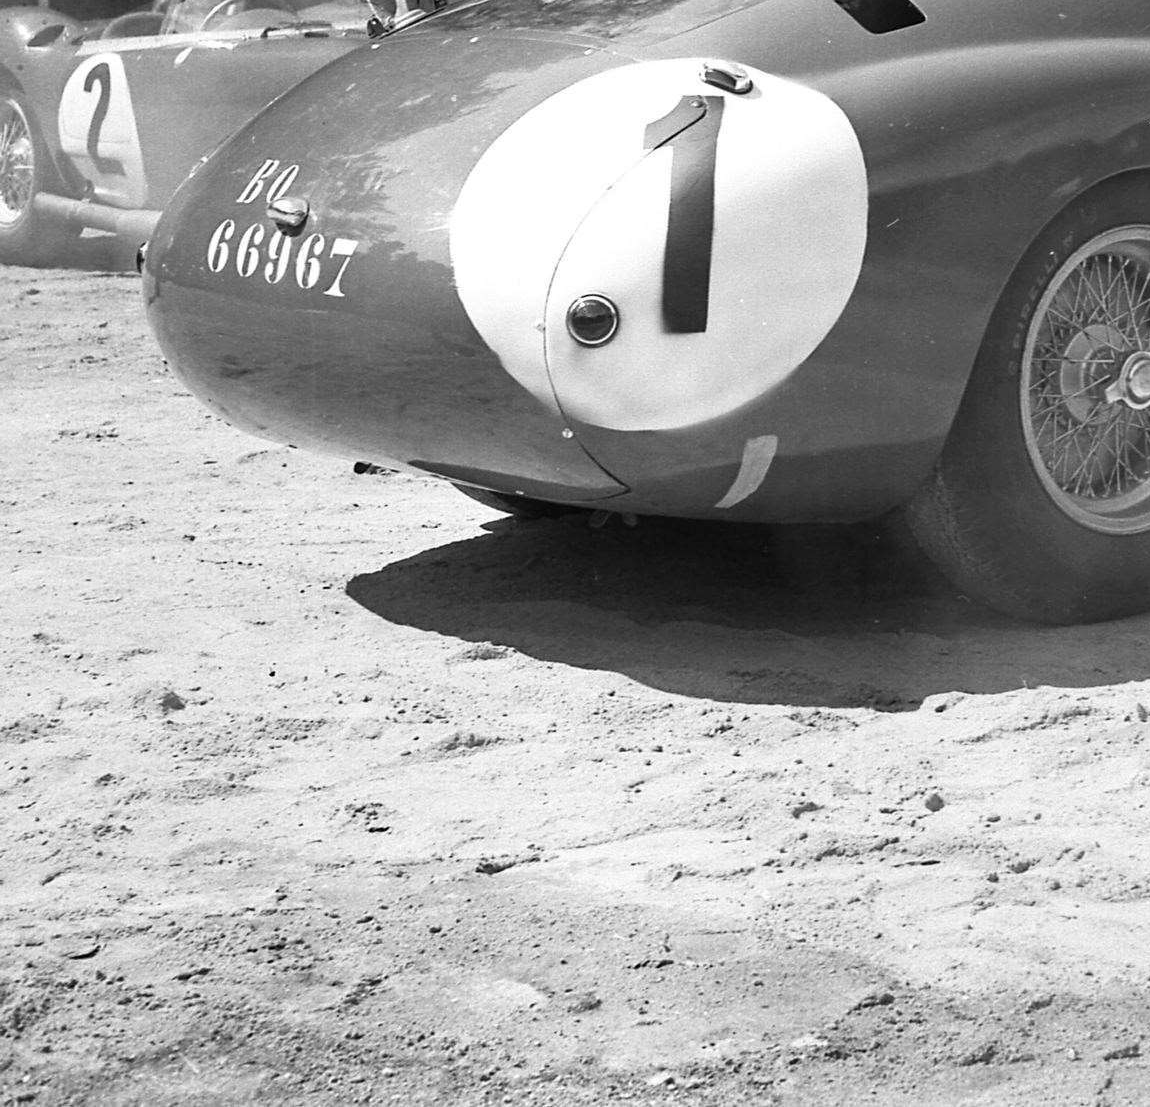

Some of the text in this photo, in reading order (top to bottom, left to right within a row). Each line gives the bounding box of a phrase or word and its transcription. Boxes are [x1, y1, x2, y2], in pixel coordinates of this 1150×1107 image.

[84, 62, 126, 176] 2
[236, 159, 300, 204] BO
[643, 96, 725, 333] 1
[207, 219, 359, 298] 66967
